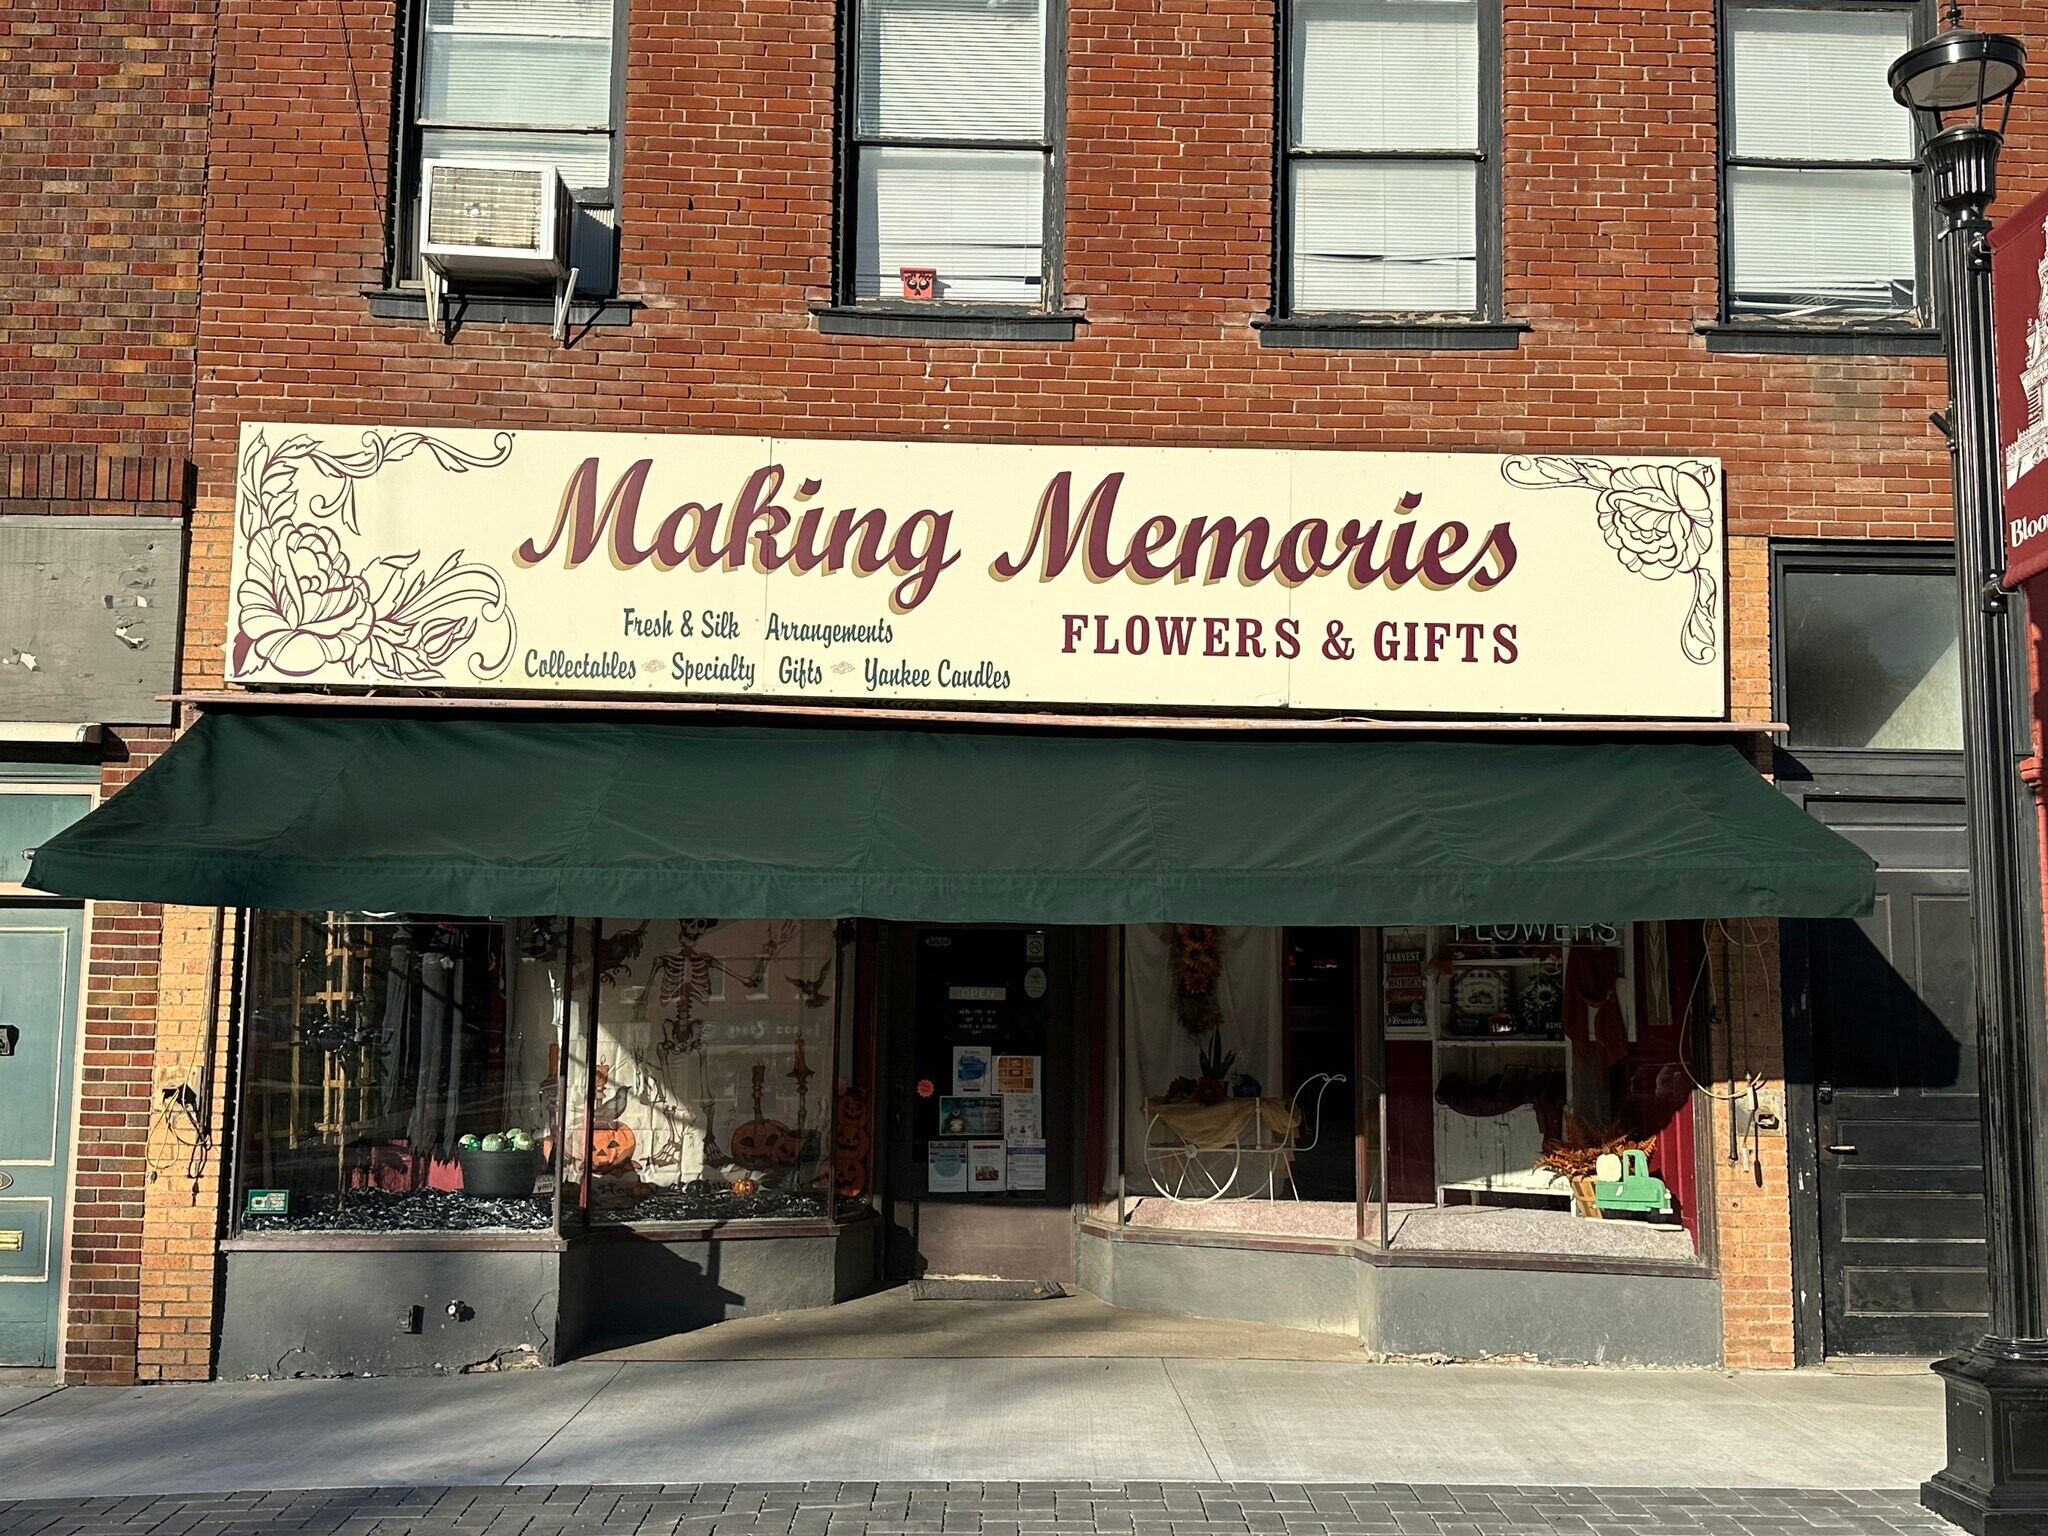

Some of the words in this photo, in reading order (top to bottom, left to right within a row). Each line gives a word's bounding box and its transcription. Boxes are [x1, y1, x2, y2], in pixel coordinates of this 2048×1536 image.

[512, 457, 962, 615] Making
[988, 471, 1518, 592] Memories
[2009, 514, 2048, 548] Bloo
[623, 607, 674, 638] Fresh
[680, 611, 694, 637] &
[701, 610, 741, 640] Silk
[765, 613, 894, 649] Arrangements
[1061, 614, 1301, 660] FLOWERS
[1321, 619, 1356, 661] &
[1373, 620, 1519, 664] GIFTS
[524, 648, 637, 680] Collectables
[671, 652, 757, 688] Specialty
[778, 655, 823, 685] Gifts
[864, 658, 931, 691] Yankee
[937, 658, 1012, 690] Candles
[1385, 950, 1421, 963] HARVEST
[960, 988, 995, 998] OPEN
[1388, 977, 1420, 987] HAYRIDES
